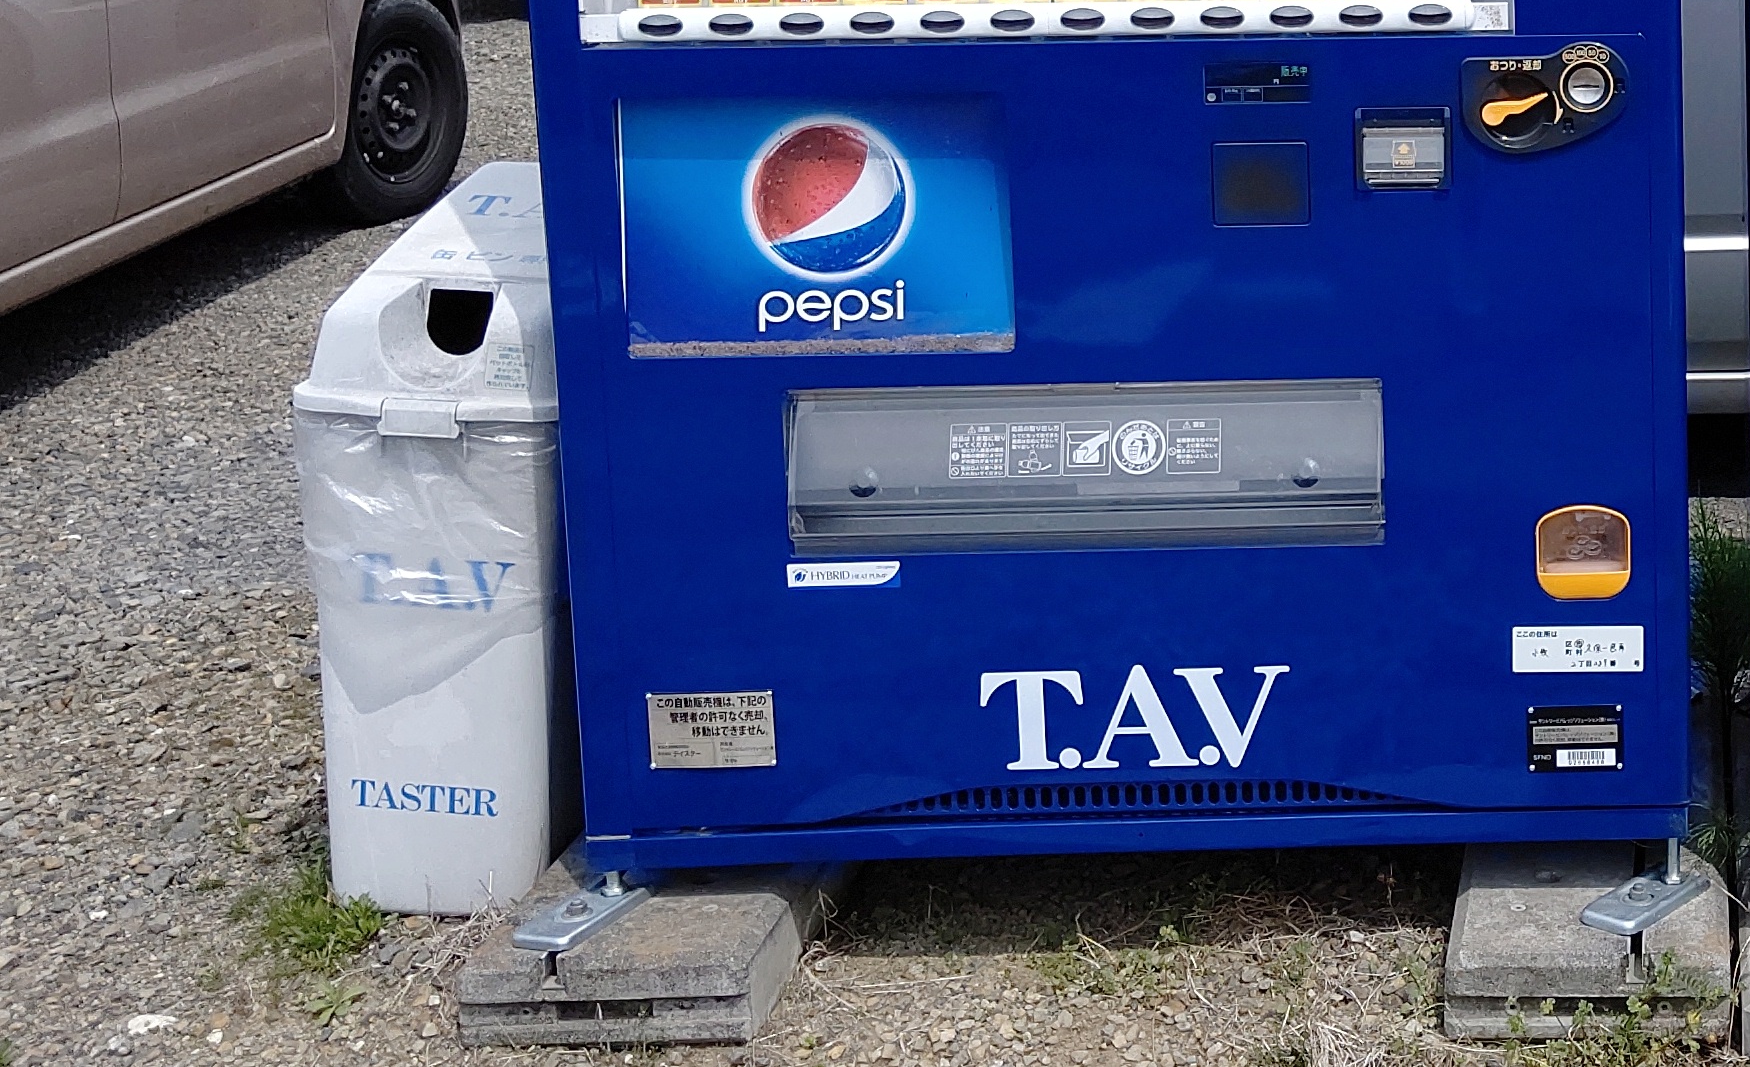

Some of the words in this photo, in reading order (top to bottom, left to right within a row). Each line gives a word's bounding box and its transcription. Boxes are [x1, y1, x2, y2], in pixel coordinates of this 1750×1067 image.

[1489, 59, 1542, 71] おつり・返却
[430, 248, 458, 260] 缶
[466, 250, 513, 262] ビン
[758, 280, 905, 333] pepsi
[810, 570, 850, 581] HYBRID
[980, 665, 1290, 770] T.A.V
[351, 778, 499, 818] TASTER
